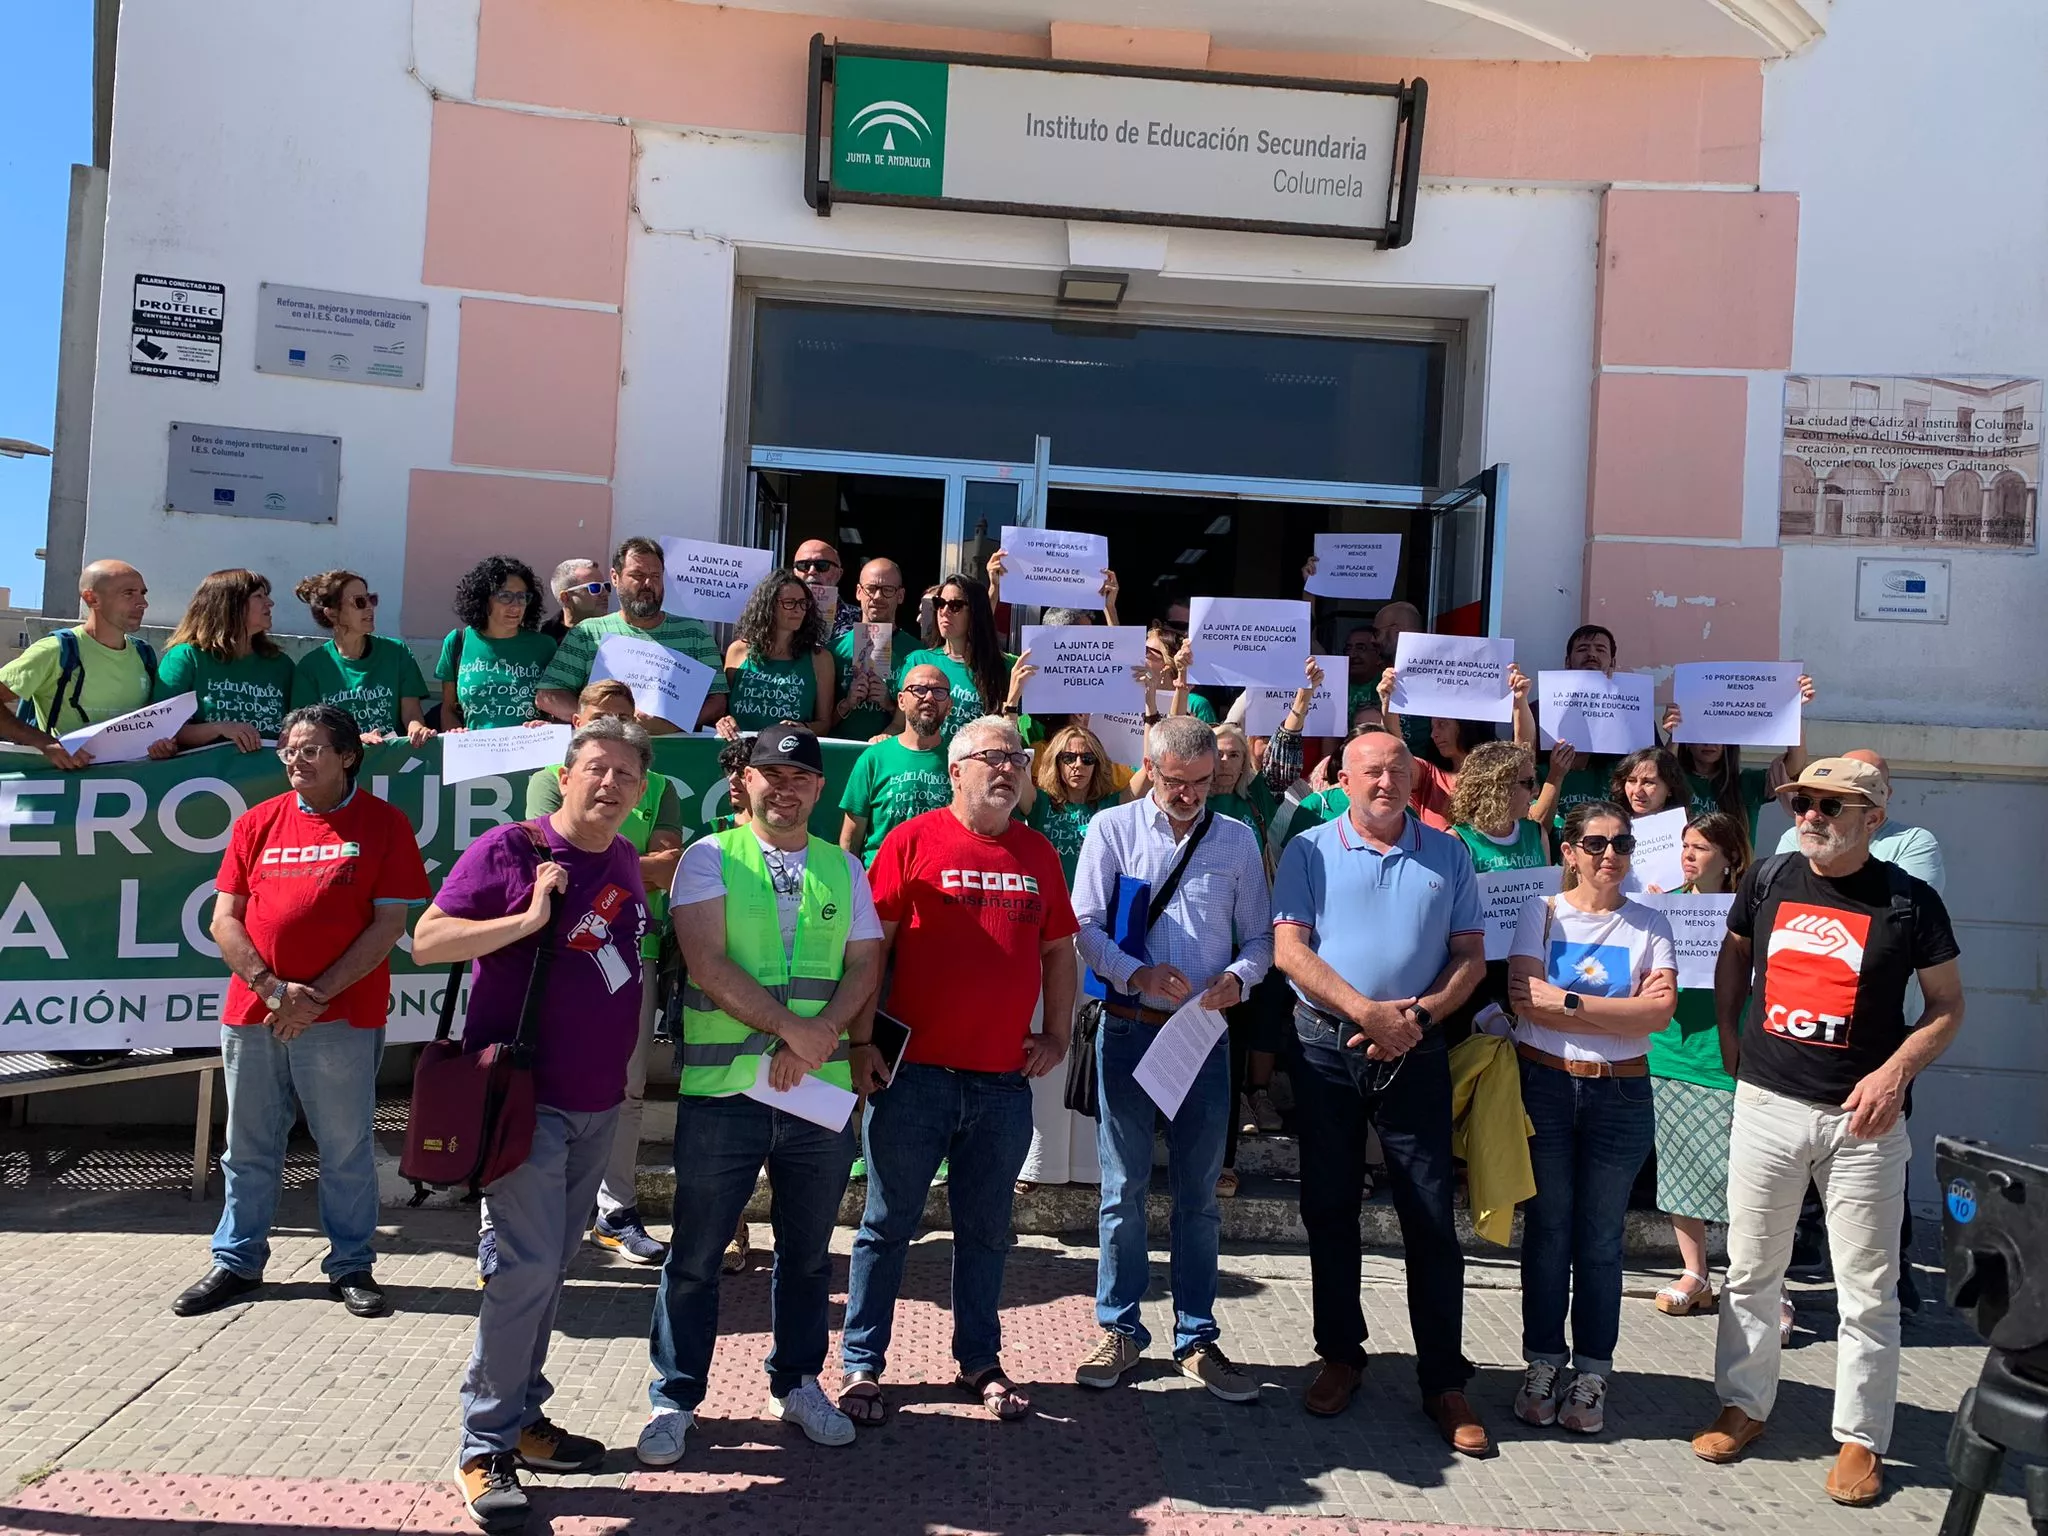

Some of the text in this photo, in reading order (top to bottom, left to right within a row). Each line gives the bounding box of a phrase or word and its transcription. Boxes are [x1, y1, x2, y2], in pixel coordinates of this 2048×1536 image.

[1026, 113, 1367, 161] Instituto de Educación Secundaria
[846, 152, 870, 164] JUNTA
[874, 154, 884, 165] DE
[1273, 169, 1364, 198] Columela
[142, 277, 220, 292] ALARMA CONECTADA 24H
[140, 300, 218, 317] PROTELEC
[318, 303, 348, 315] mejoras
[350, 308, 354, 316] y
[356, 308, 412, 321] modernización
[304, 310, 311, 319] el
[374, 318, 396, 329] Cádiz
[154, 329, 206, 340] VIDEOVIGILADA
[140, 366, 184, 376] PROTELEC
[1789, 415, 2034, 431] La ciudad de Cádiz al instituto Columela
[1802, 432, 1823, 441] con
[1826, 431, 1868, 441] motivo
[1872, 430, 1890, 441] del
[1918, 432, 1984, 444] aniversario
[1988, 432, 2002, 444] de
[2006, 434, 2019, 444] su
[192, 434, 213, 444] Obras
[214, 437, 224, 446] de
[226, 438, 250, 450] mejora
[252, 441, 290, 452] estructural
[302, 445, 308, 454] el
[212, 447, 245, 458] Columela
[1854, 446, 1868, 455] en
[1871, 445, 1962, 457] reconocimiento
[1978, 446, 1990, 458] la
[1994, 446, 2025, 458] labor
[1804, 456, 1851, 468] docente
[1854, 460, 1876, 468] con
[1880, 458, 1896, 469] los
[1899, 458, 1944, 472] jóvenes
[1793, 485, 1820, 495] Cádiz
[1888, 487, 1910, 497] 2013
[688, 554, 743, 568] LA JUNTA DE
[690, 565, 739, 578] ANDALUCÍA
[1045, 567, 1070, 575] PLAZAS
[676, 574, 749, 591] MALTRATA LA FP
[1026, 574, 1086, 584] ALUMNADO MENOS
[694, 587, 731, 599] PÚBLICA
[1215, 624, 1240, 632] JUNTA
[1242, 624, 1253, 632] DE
[1254, 624, 1296, 633] ANDALUCÍA
[1202, 634, 1296, 643] RECORTA EN EDUCACIÓN
[1054, 642, 1114, 650] LA JUNTA DE
[1233, 643, 1267, 652] PÚBLICA
[1056, 653, 1112, 662] ANDALUCÍA
[1420, 658, 1444, 666] JUNTA
[1044, 666, 1123, 674] MALTRATA LA FP
[1406, 666, 1442, 675] RECORTA
[1064, 676, 1105, 686] PÚBLICA
[461, 686, 477, 696] DE
[1590, 692, 1601, 700] DE
[160, 707, 172, 715] FP
[216, 700, 233, 711] DE
[1747, 710, 1774, 718] MENOS
[941, 870, 1023, 892] CCOO
[1488, 881, 1544, 894] LA JUNTA DE
[601, 889, 620, 911] Cádiz
[944, 894, 1042, 912] enseñanza
[1686, 940, 1719, 948] PLAZAS
[2, 989, 220, 1025] ACIÓN DE
[1768, 1004, 1846, 1042] CGT
[1955, 1200, 1969, 1217] 10
